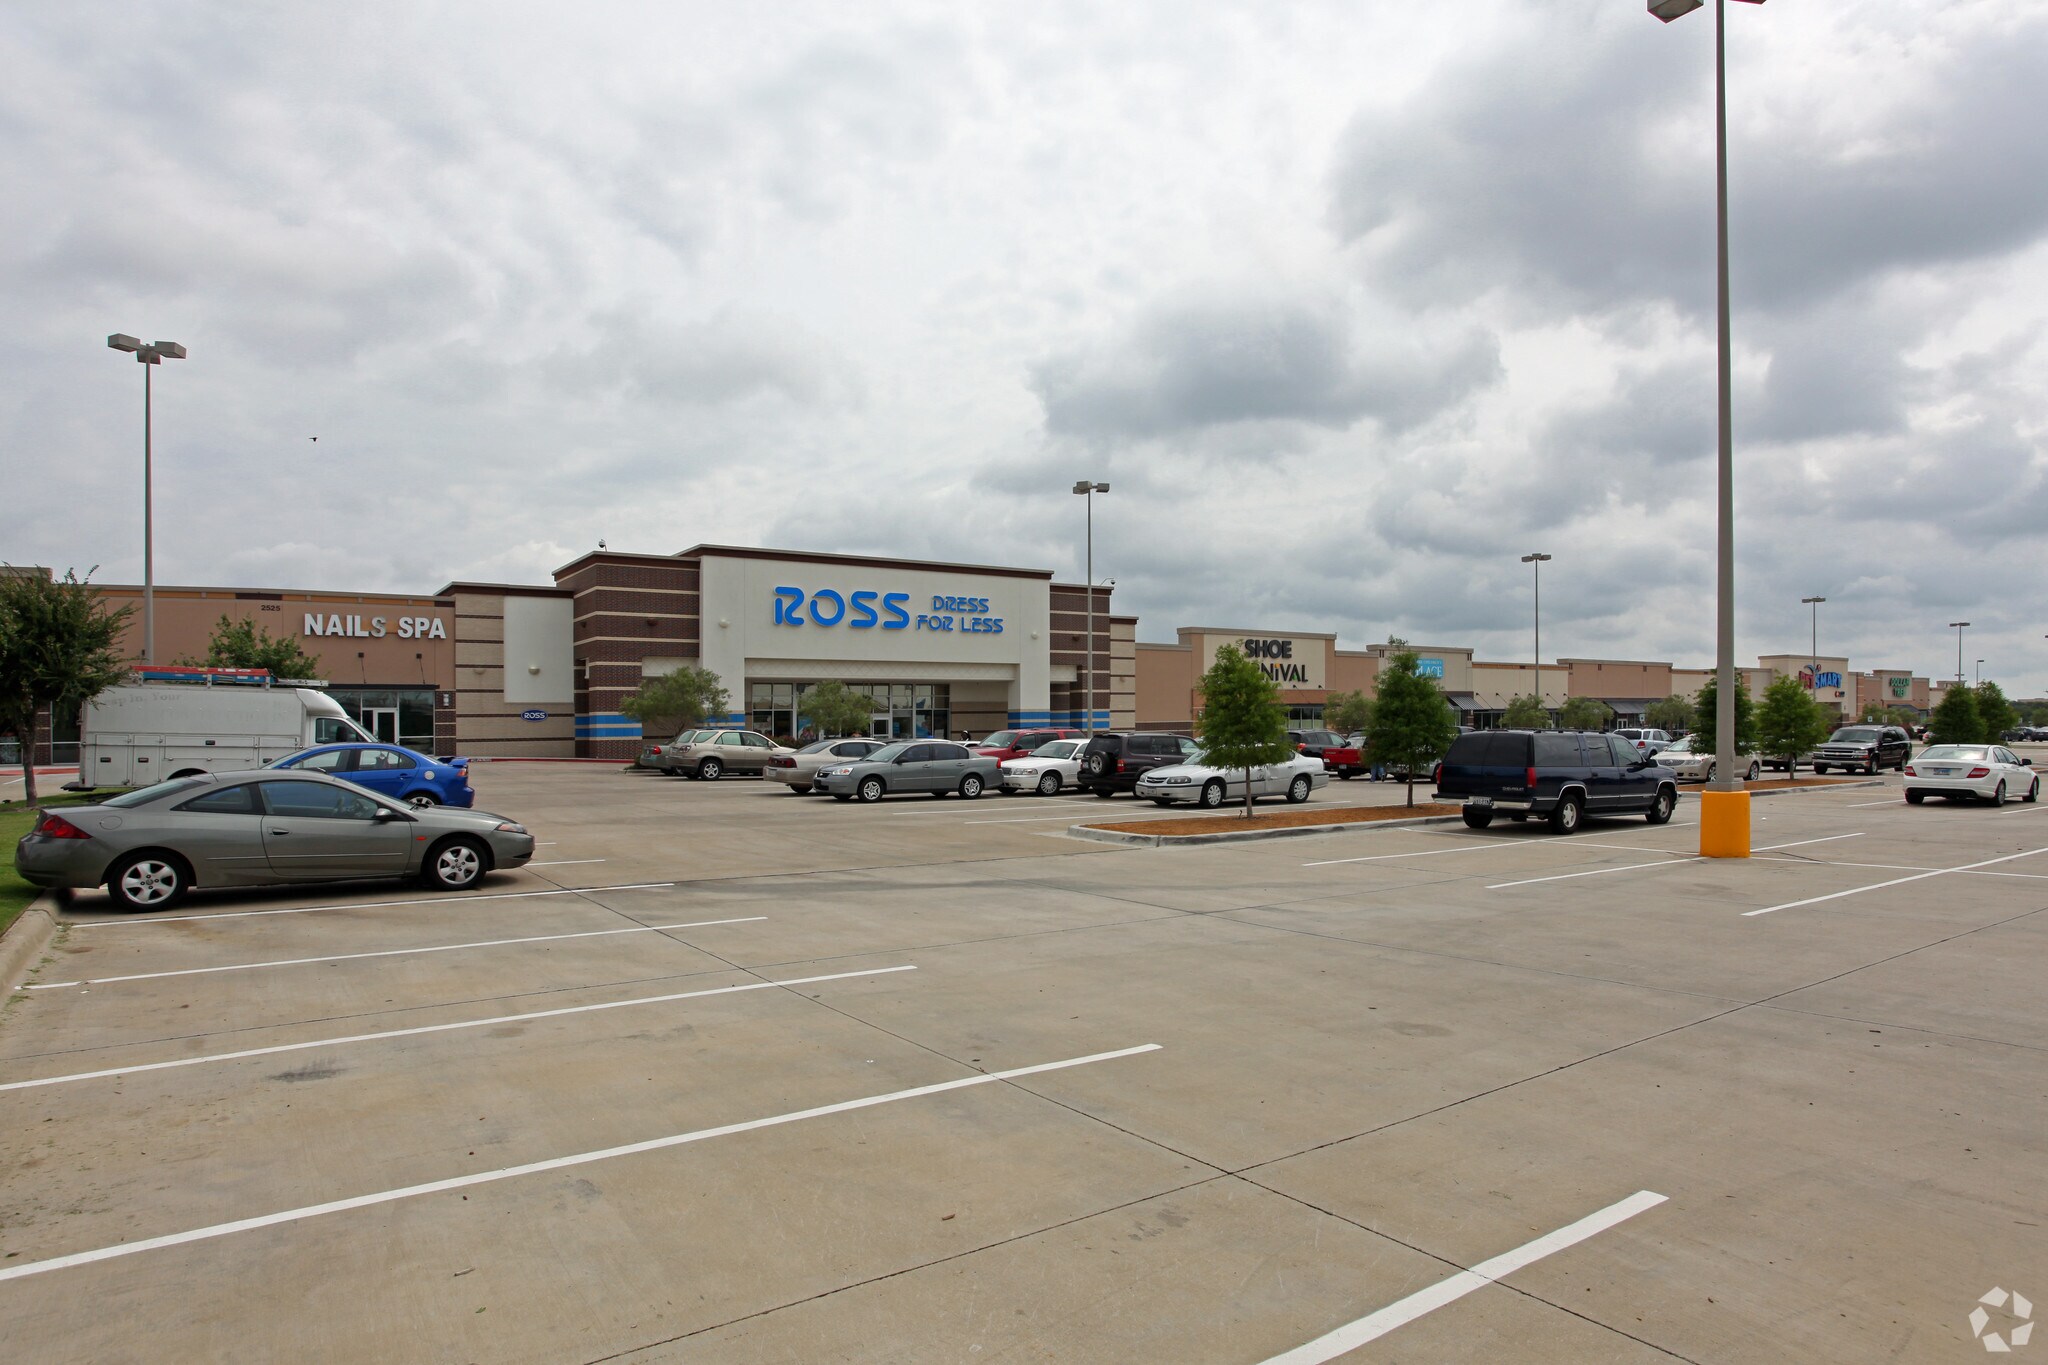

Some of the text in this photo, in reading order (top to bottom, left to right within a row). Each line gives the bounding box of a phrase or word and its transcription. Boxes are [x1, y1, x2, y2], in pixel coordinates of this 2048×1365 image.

[260, 604, 281, 612] 2525
[774, 586, 910, 630] ROSS
[932, 595, 990, 613] DRESS
[304, 613, 447, 640] NAILS SPA
[917, 614, 1004, 634] FOR LESS
[1245, 639, 1292, 659] SHOE
